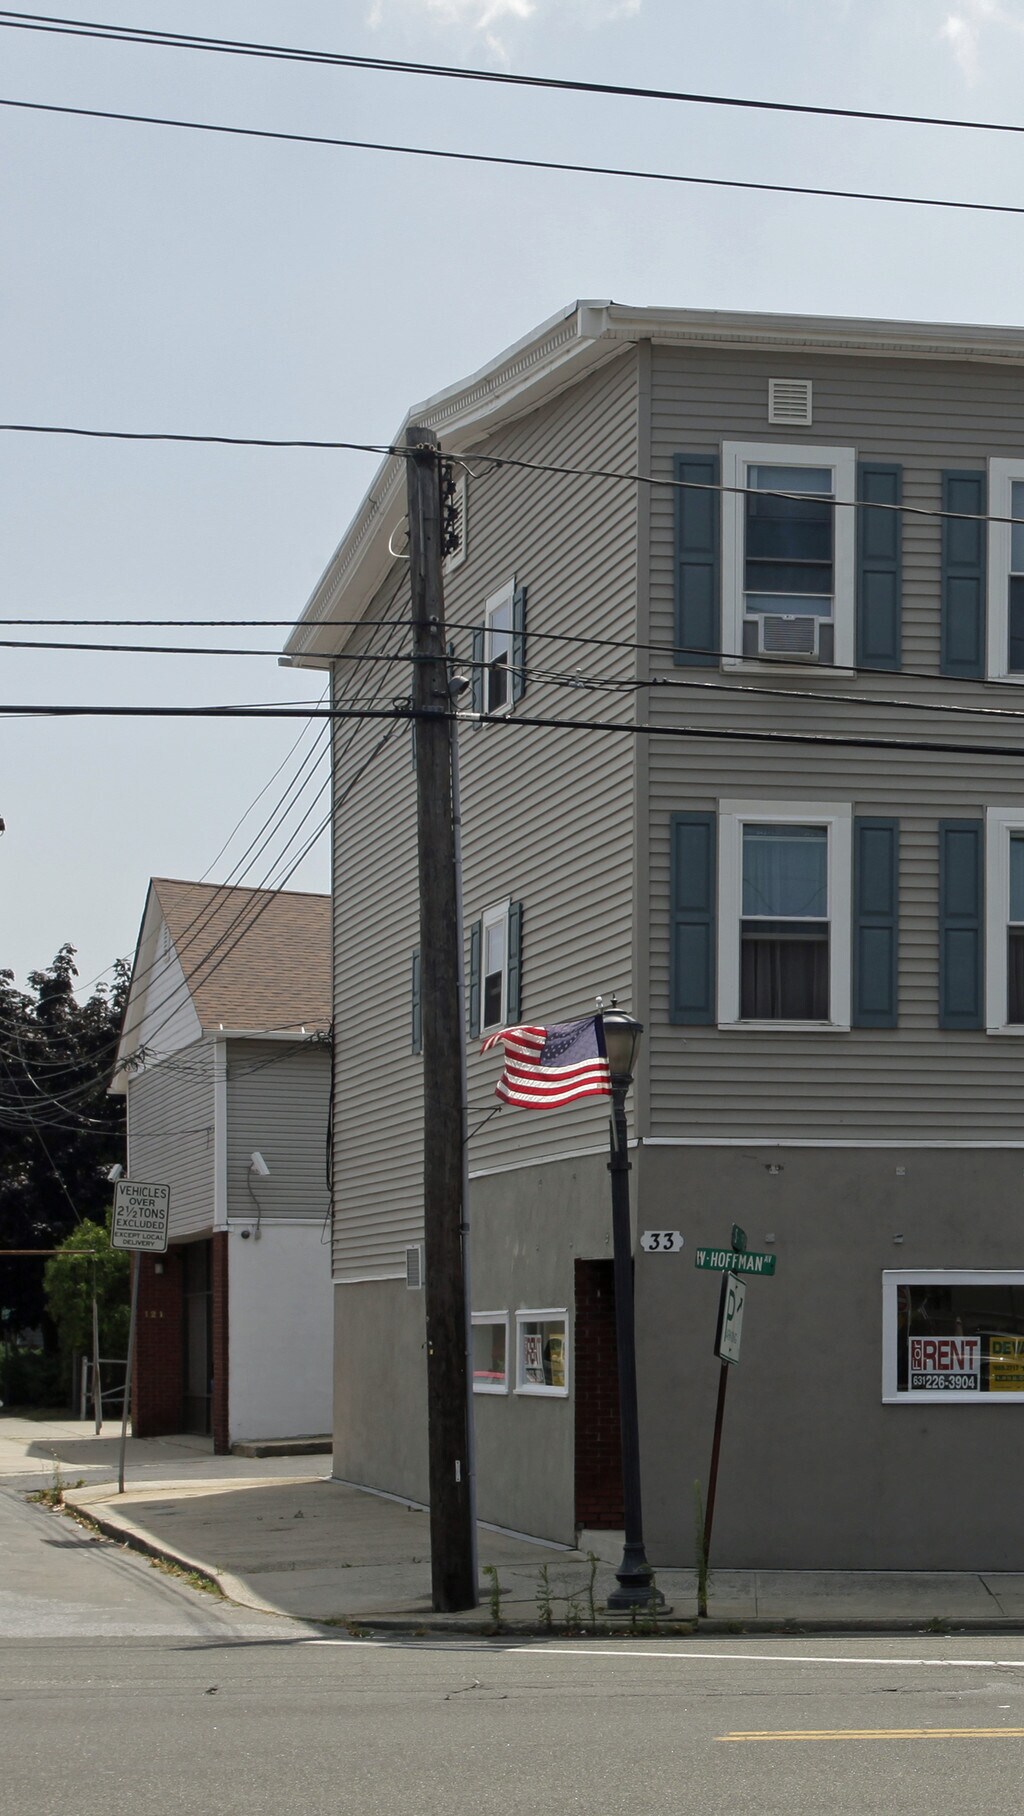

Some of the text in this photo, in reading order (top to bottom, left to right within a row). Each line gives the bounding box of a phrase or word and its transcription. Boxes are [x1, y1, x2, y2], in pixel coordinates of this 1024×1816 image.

[119, 1185, 167, 1199] VEHICLES
[129, 1197, 155, 1207] OVER
[139, 1207, 165, 1220] TONS
[116, 1218, 165, 1230] EXCLUDED
[114, 1231, 164, 1241] EXCEPT LOCAL
[649, 1232, 674, 1251] 33
[122, 1239, 155, 1247] DELIVERY
[710, 1251, 763, 1272] HOFFMAN
[763, 1255, 773, 1264] AV
[923, 1340, 978, 1371] RENT
